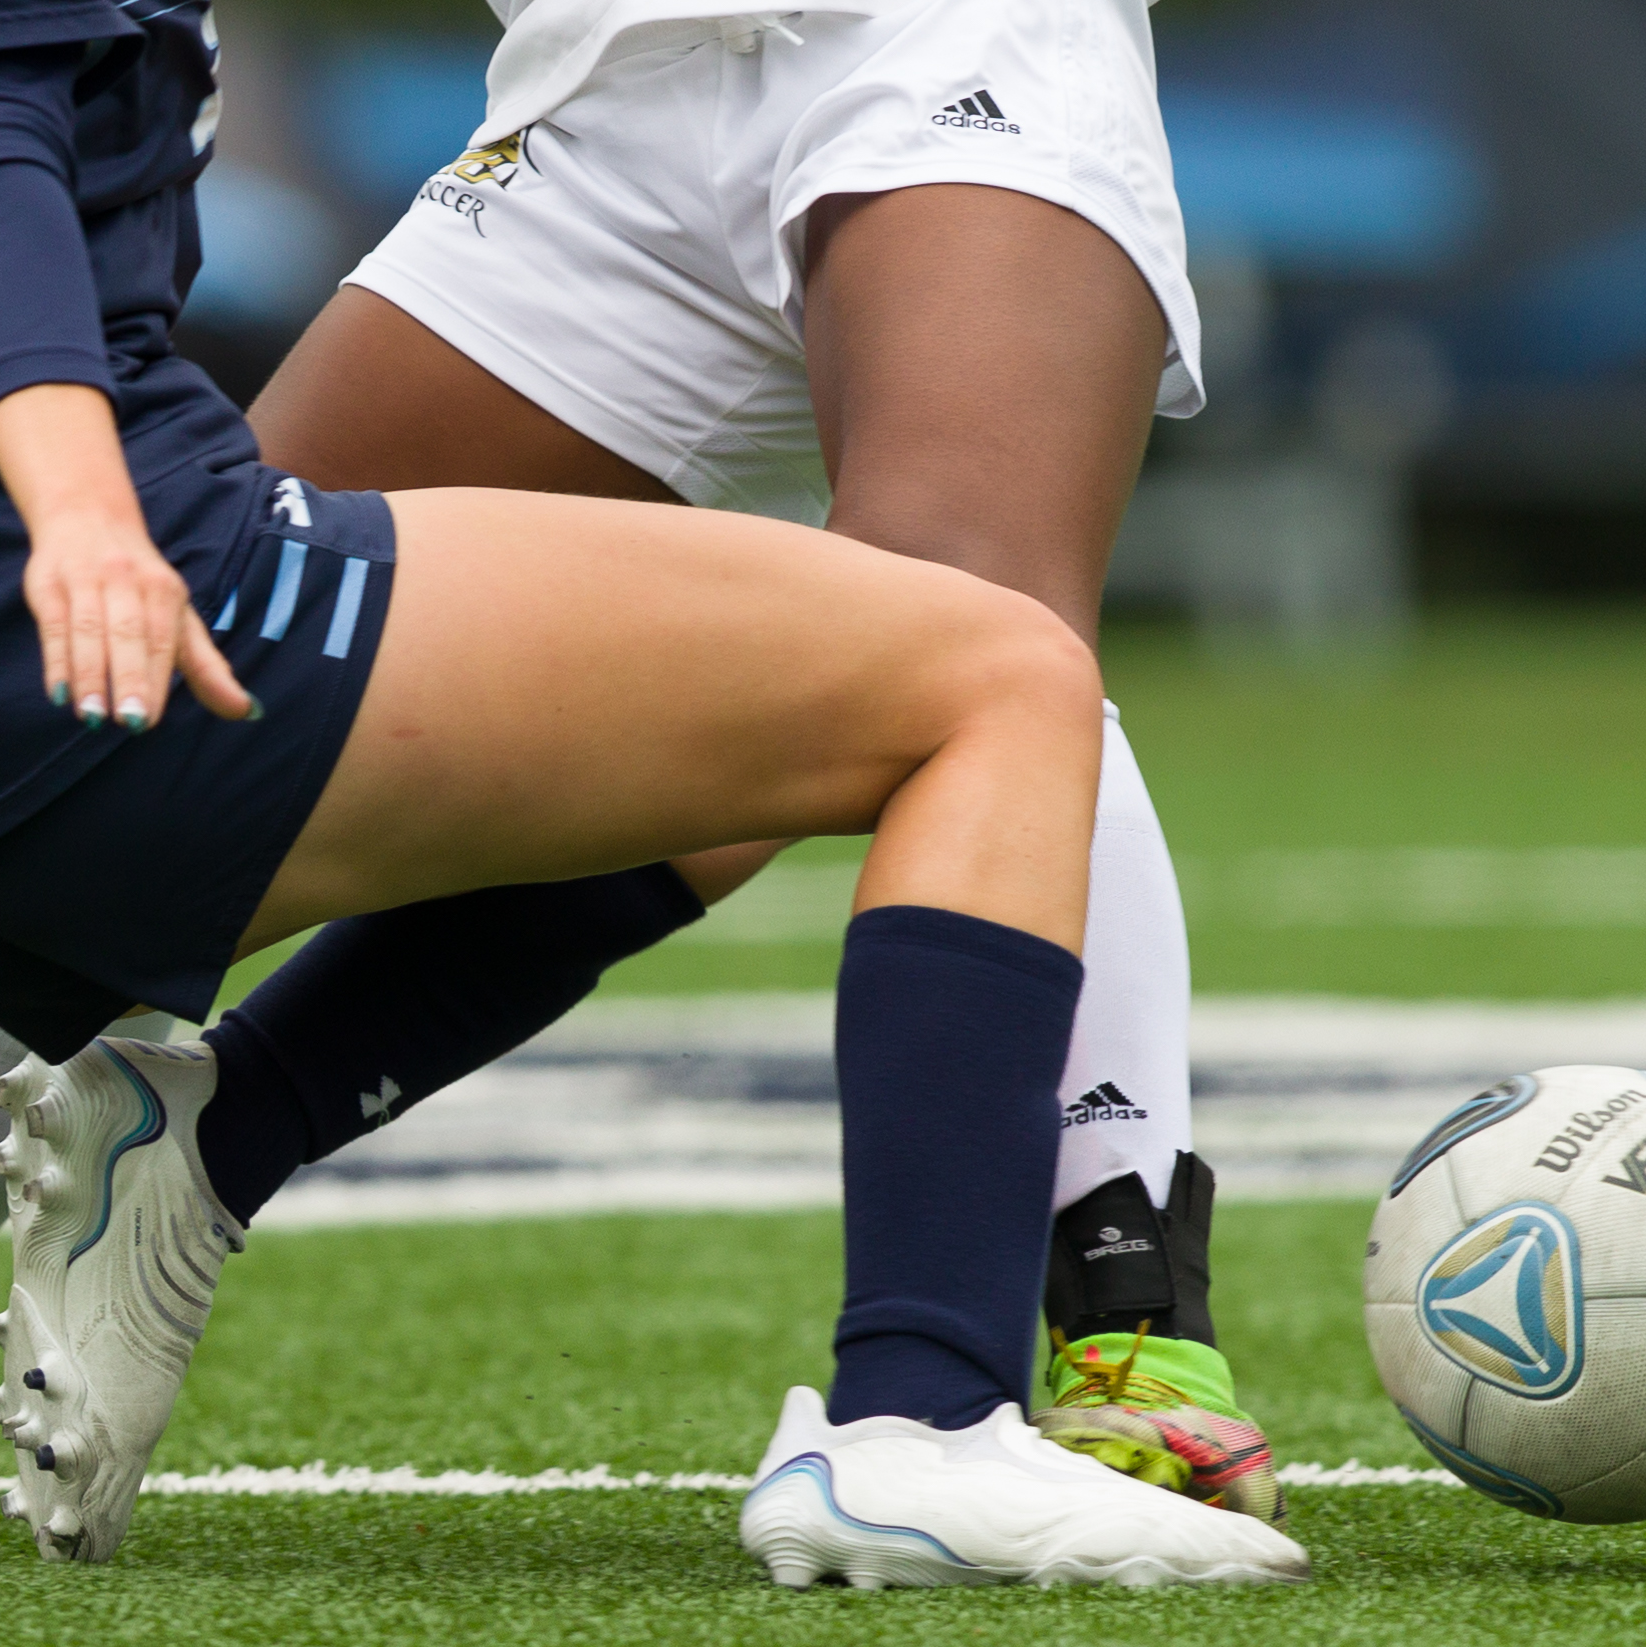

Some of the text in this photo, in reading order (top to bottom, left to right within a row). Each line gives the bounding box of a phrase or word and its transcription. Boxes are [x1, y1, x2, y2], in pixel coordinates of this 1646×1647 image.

[932, 114, 1021, 135] adidas
[1060, 1105, 1148, 1129] adidas
[1084, 1239, 1152, 1261] BREG
